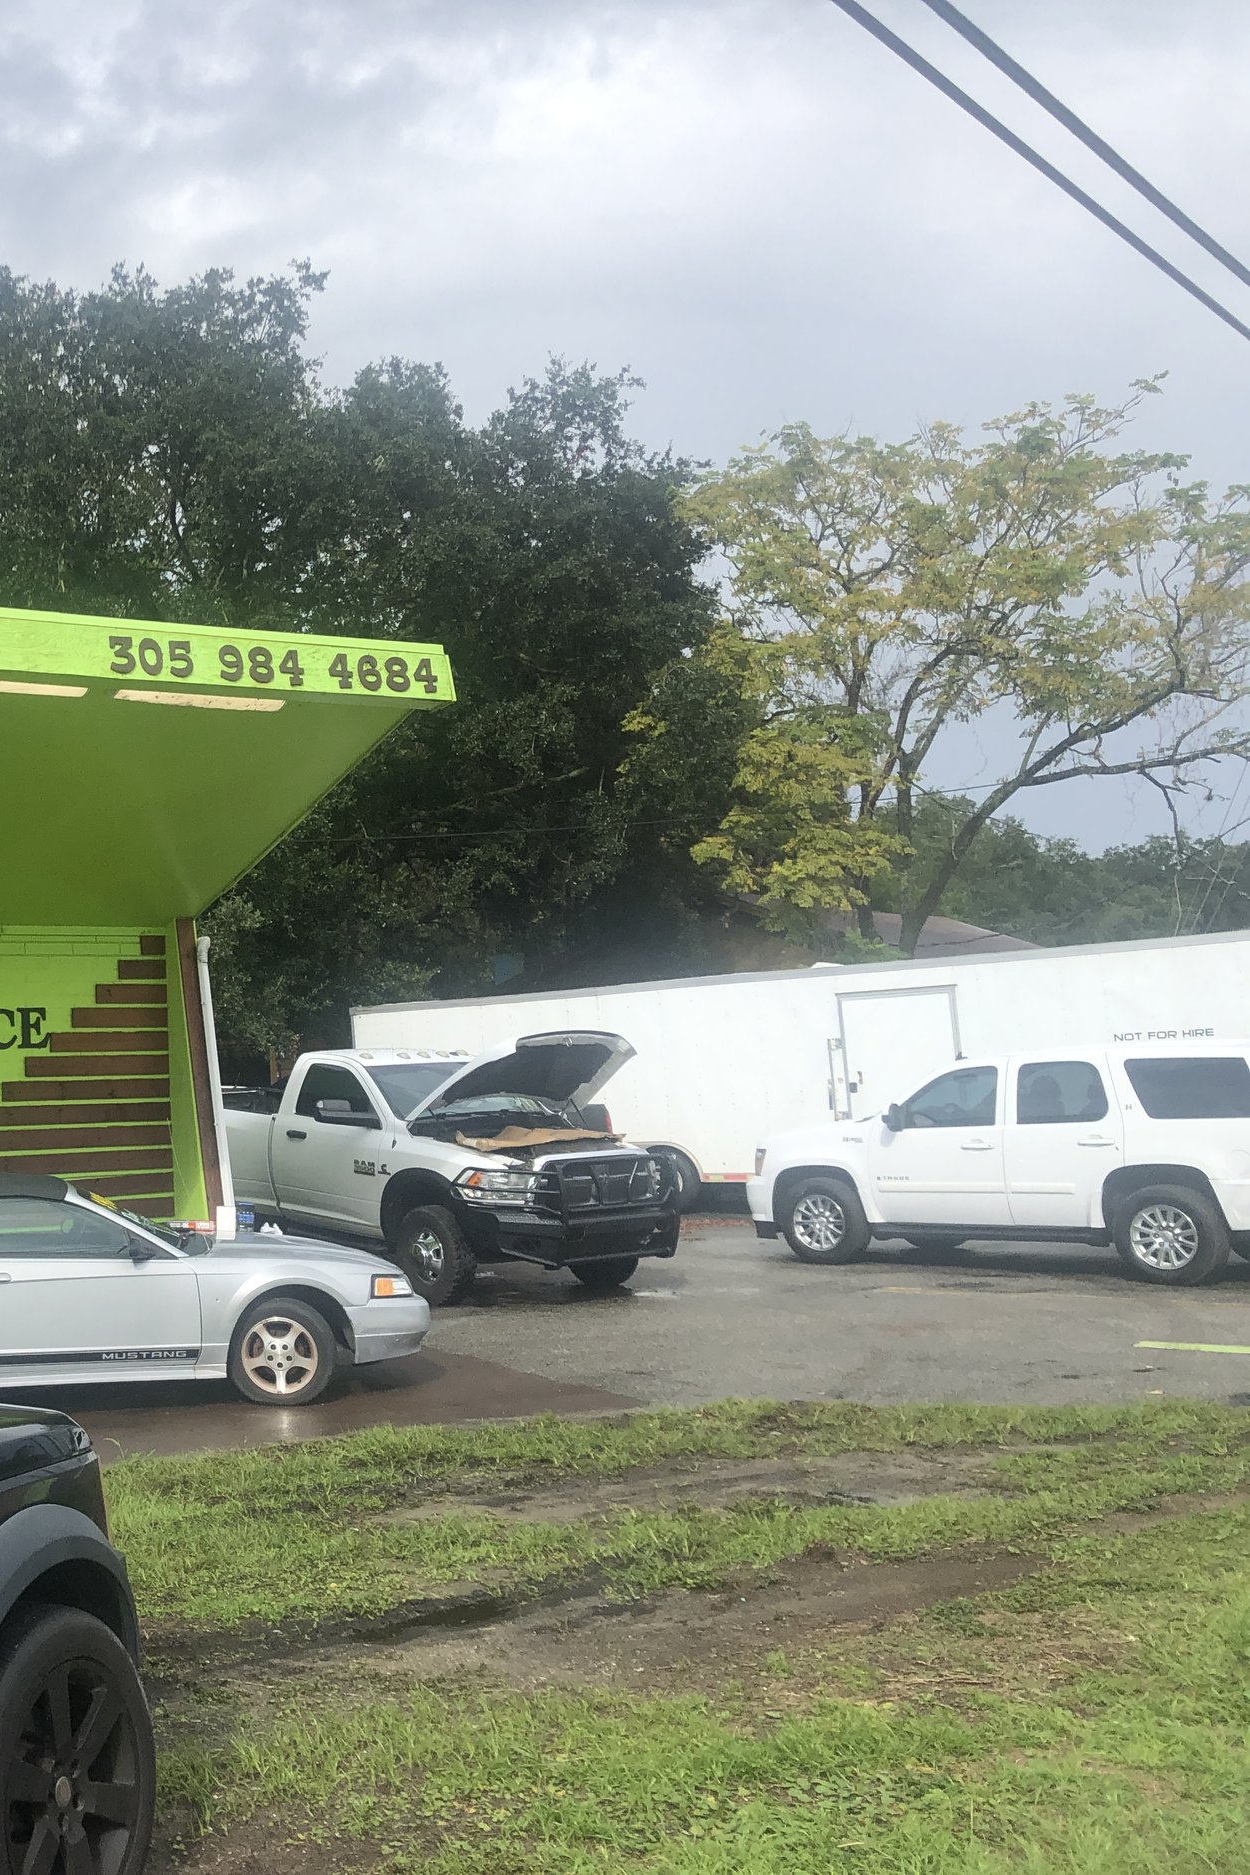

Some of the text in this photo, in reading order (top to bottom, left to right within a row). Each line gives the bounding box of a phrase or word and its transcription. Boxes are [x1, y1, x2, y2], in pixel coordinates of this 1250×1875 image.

[109, 635, 438, 694] 305 984 4684
[1114, 1028, 1215, 1042] NOT FOR HIRE
[353, 1159, 375, 1168] RAM
[102, 1350, 187, 1361] MUSTANG
